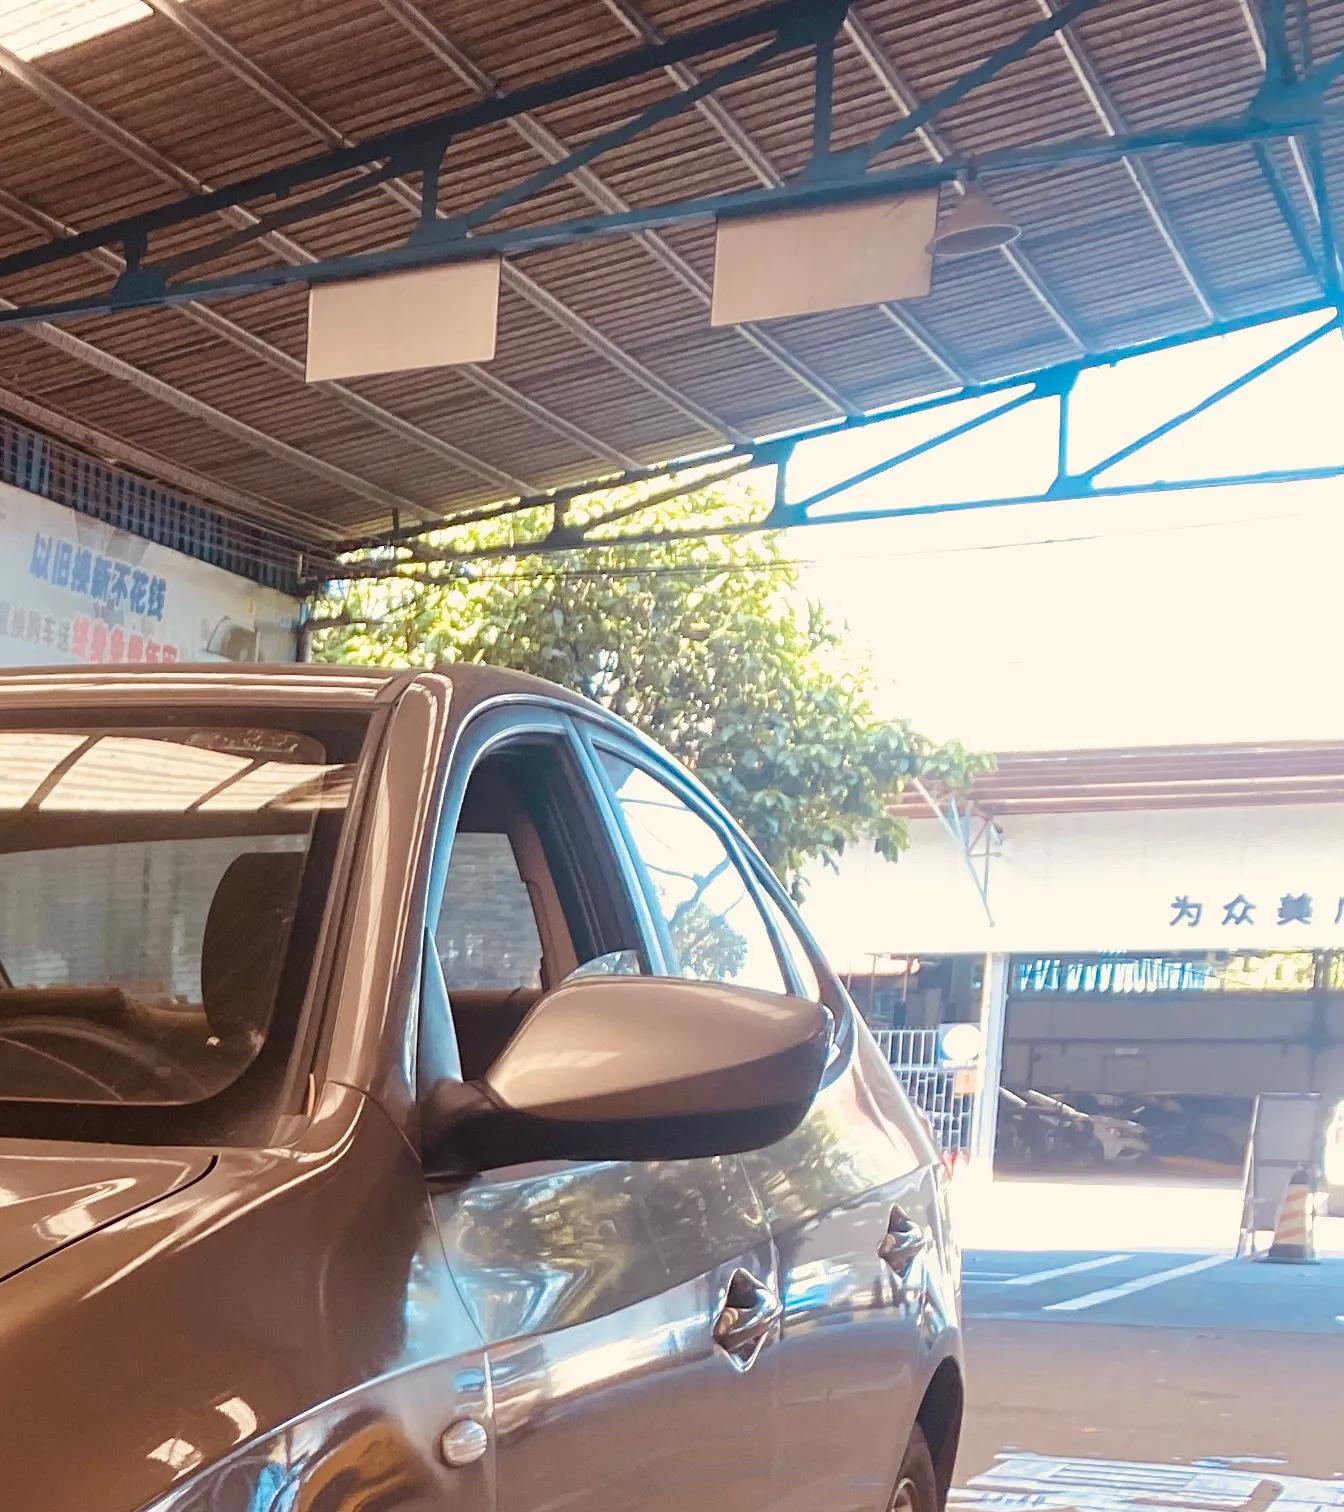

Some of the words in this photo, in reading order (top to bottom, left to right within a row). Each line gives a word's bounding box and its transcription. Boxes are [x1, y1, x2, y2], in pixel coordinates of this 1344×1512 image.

[29, 531, 167, 622] 以旧换新不花钱
